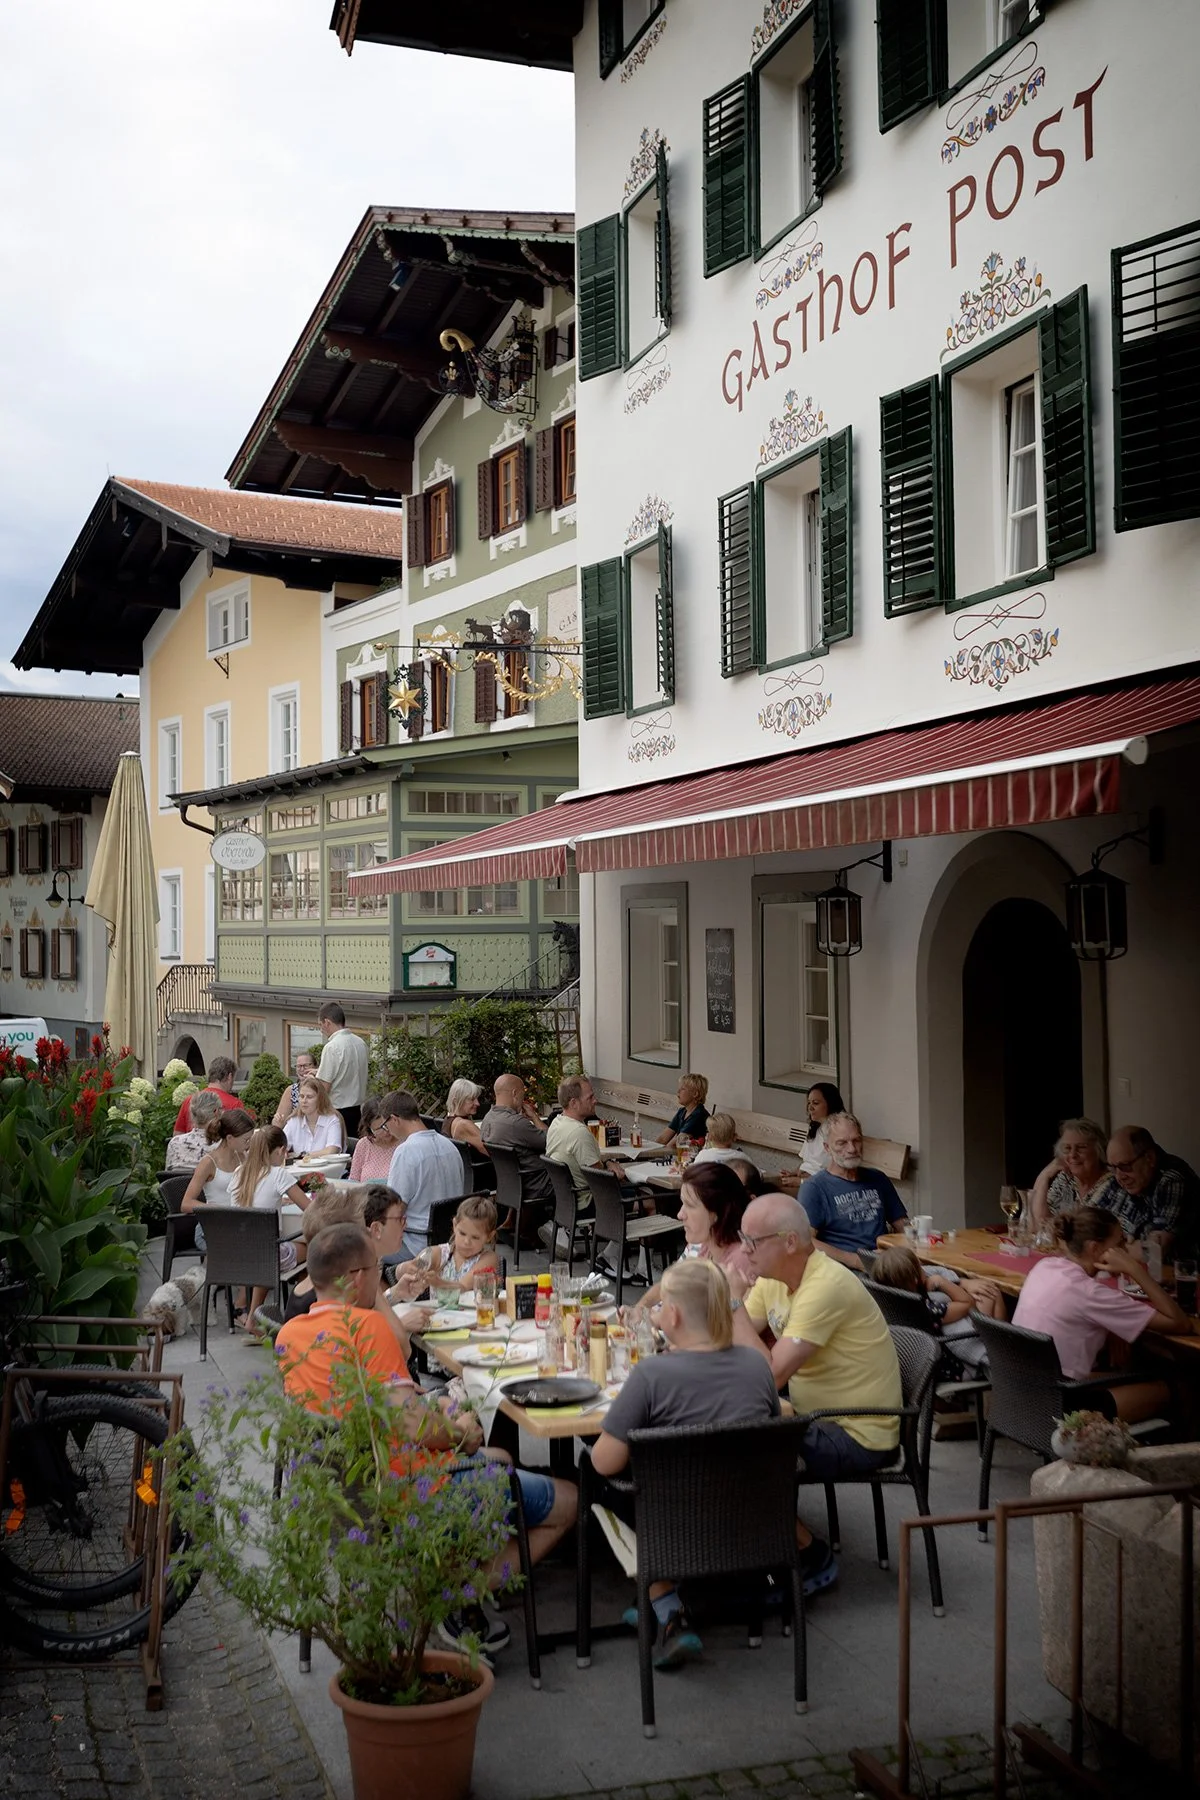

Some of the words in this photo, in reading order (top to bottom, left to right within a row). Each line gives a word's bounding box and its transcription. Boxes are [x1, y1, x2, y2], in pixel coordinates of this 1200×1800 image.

[946, 64, 1109, 269] POST
[7, 1031, 35, 1045] you
[42, 1628, 131, 1652] KENDA
